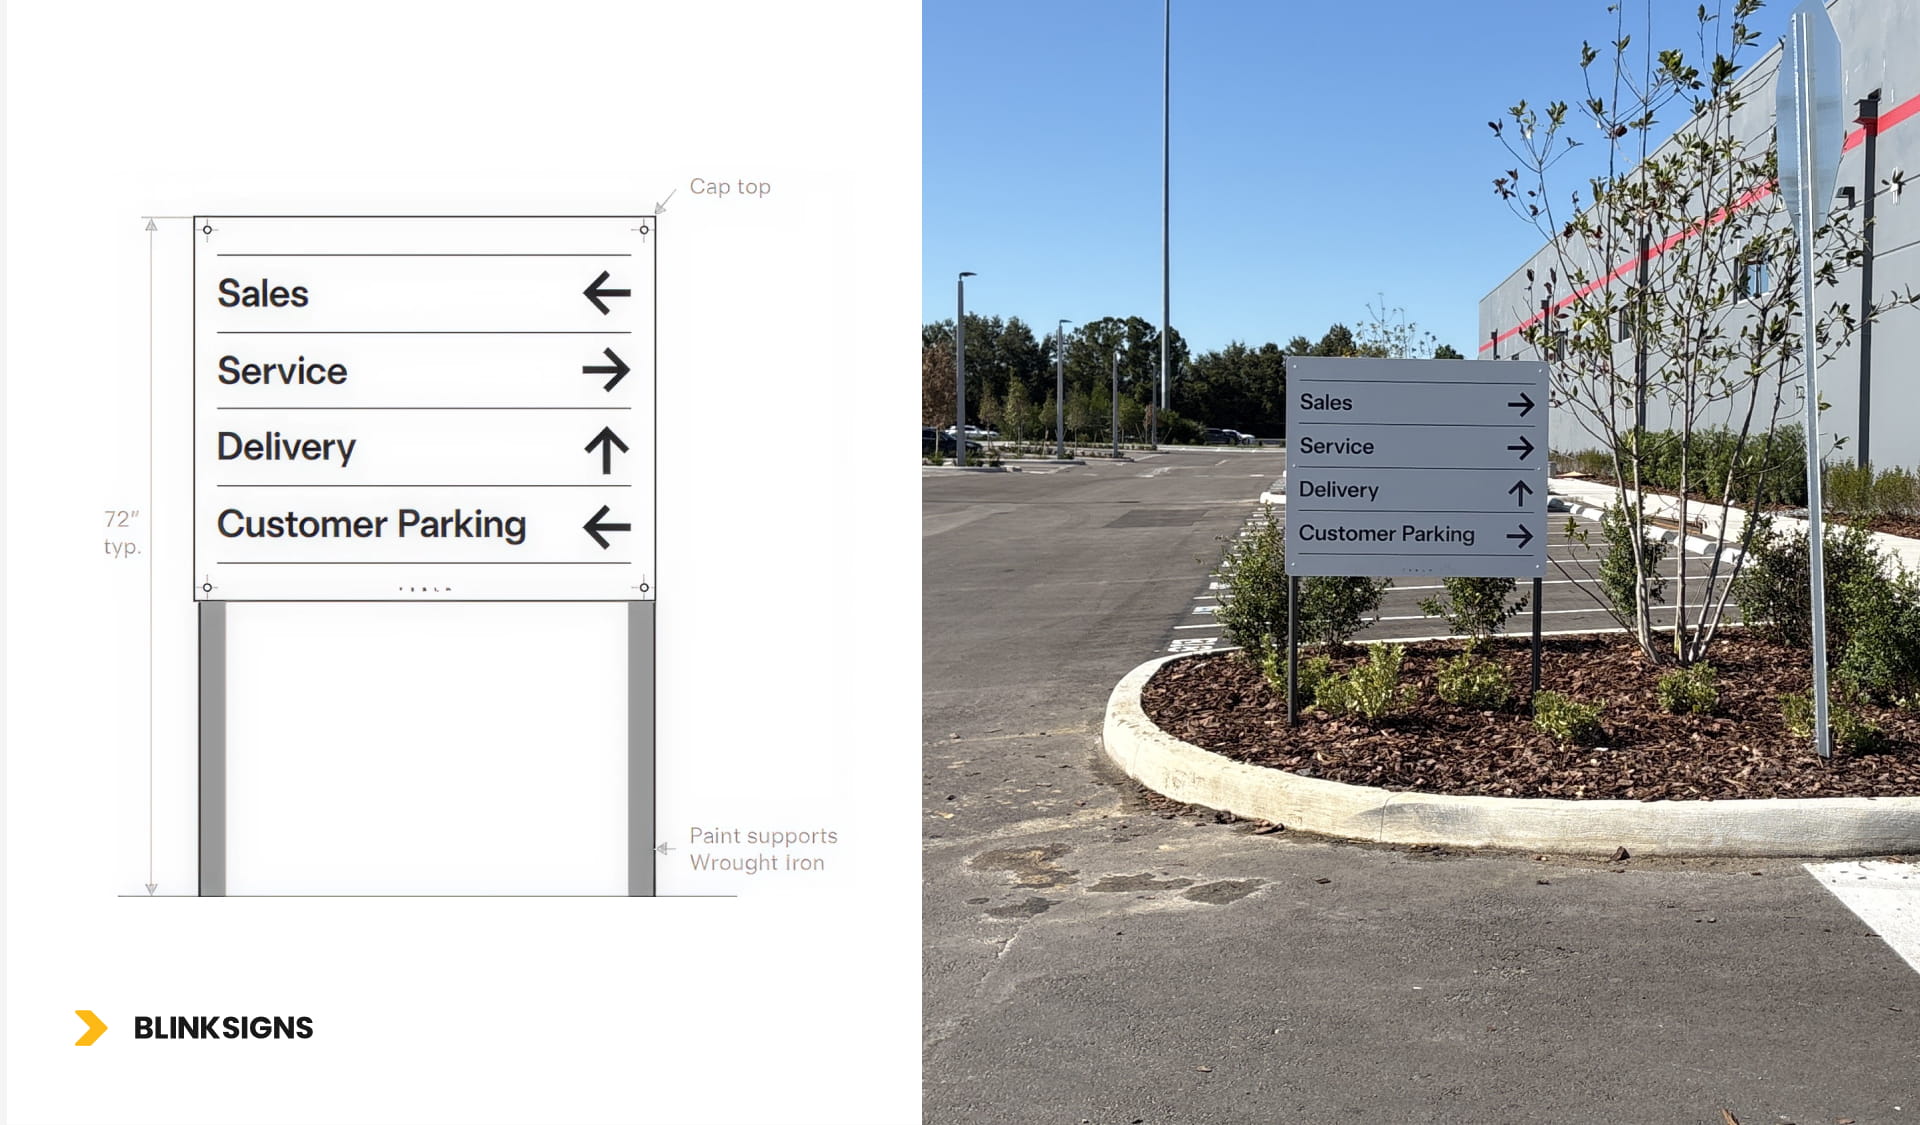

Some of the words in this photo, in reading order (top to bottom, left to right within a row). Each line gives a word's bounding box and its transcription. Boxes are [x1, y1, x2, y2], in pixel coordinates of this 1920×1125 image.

[217, 277, 309, 308] Sales
[217, 354, 348, 385] Service
[1300, 392, 1353, 411] Sales
[217, 431, 357, 468] Delivery
[1300, 436, 1375, 455] Service
[1299, 480, 1380, 503] Delivery
[217, 508, 389, 538] Customer
[398, 508, 526, 546] Parking
[1298, 523, 1397, 542] Customer
[1402, 524, 1475, 547] Parking
